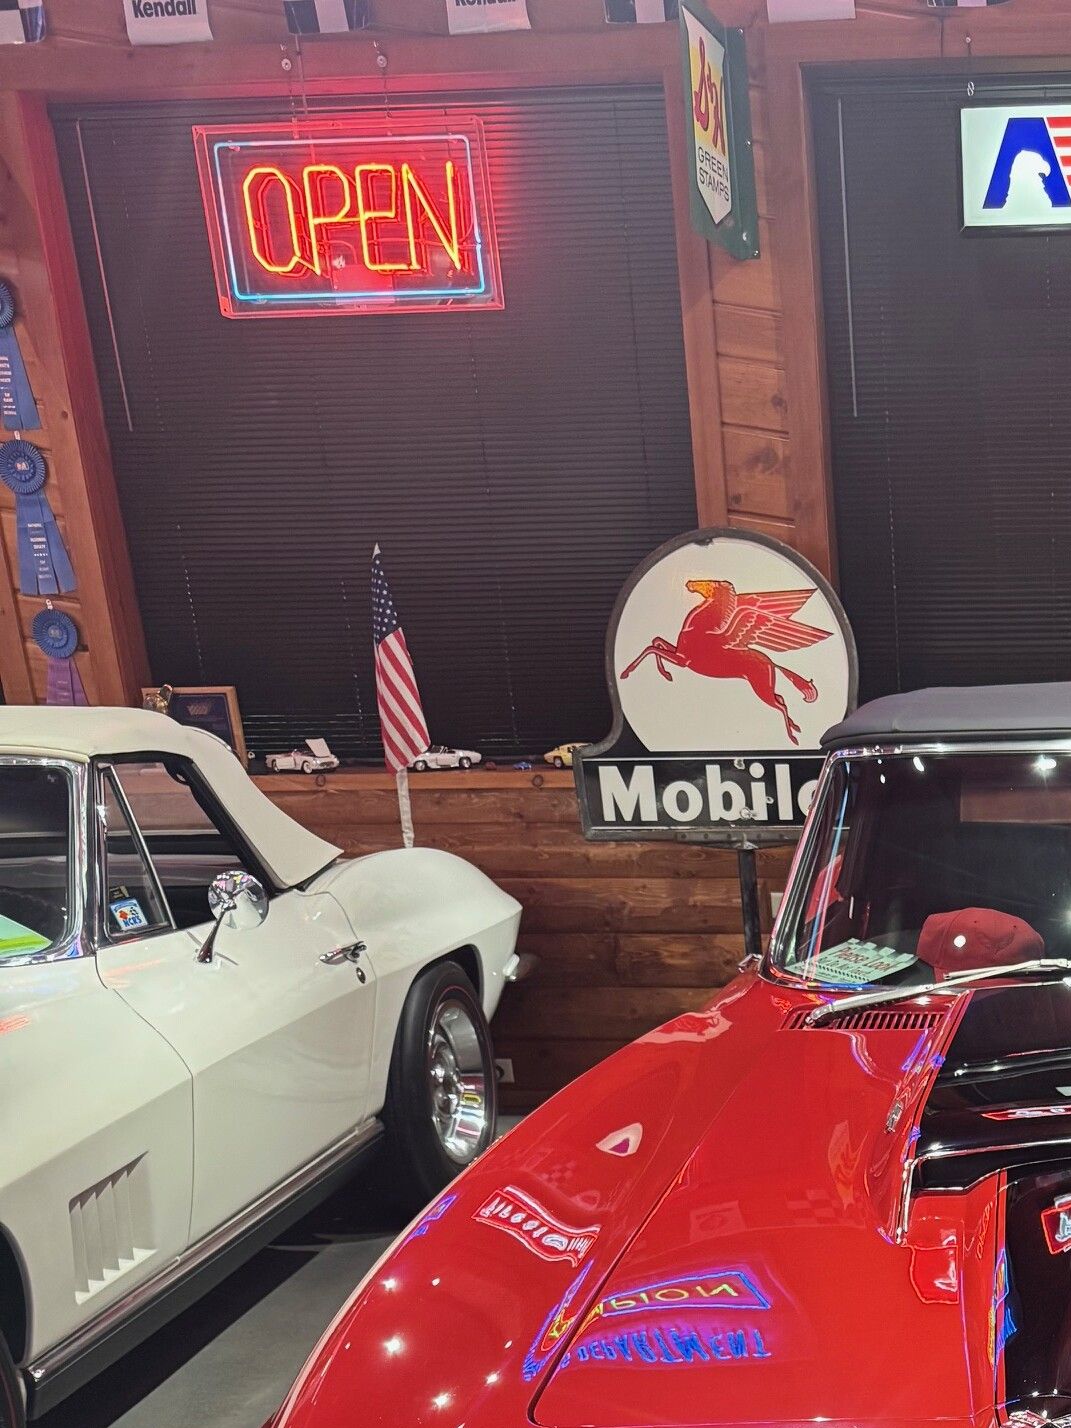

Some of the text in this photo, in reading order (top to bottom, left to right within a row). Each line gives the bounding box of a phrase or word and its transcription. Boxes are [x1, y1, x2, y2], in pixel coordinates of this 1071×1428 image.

[132, 0, 197, 18] Kendall
[697, 146, 729, 184] GREEN
[698, 166, 730, 202] STAMPS
[243, 160, 462, 276] OPEN
